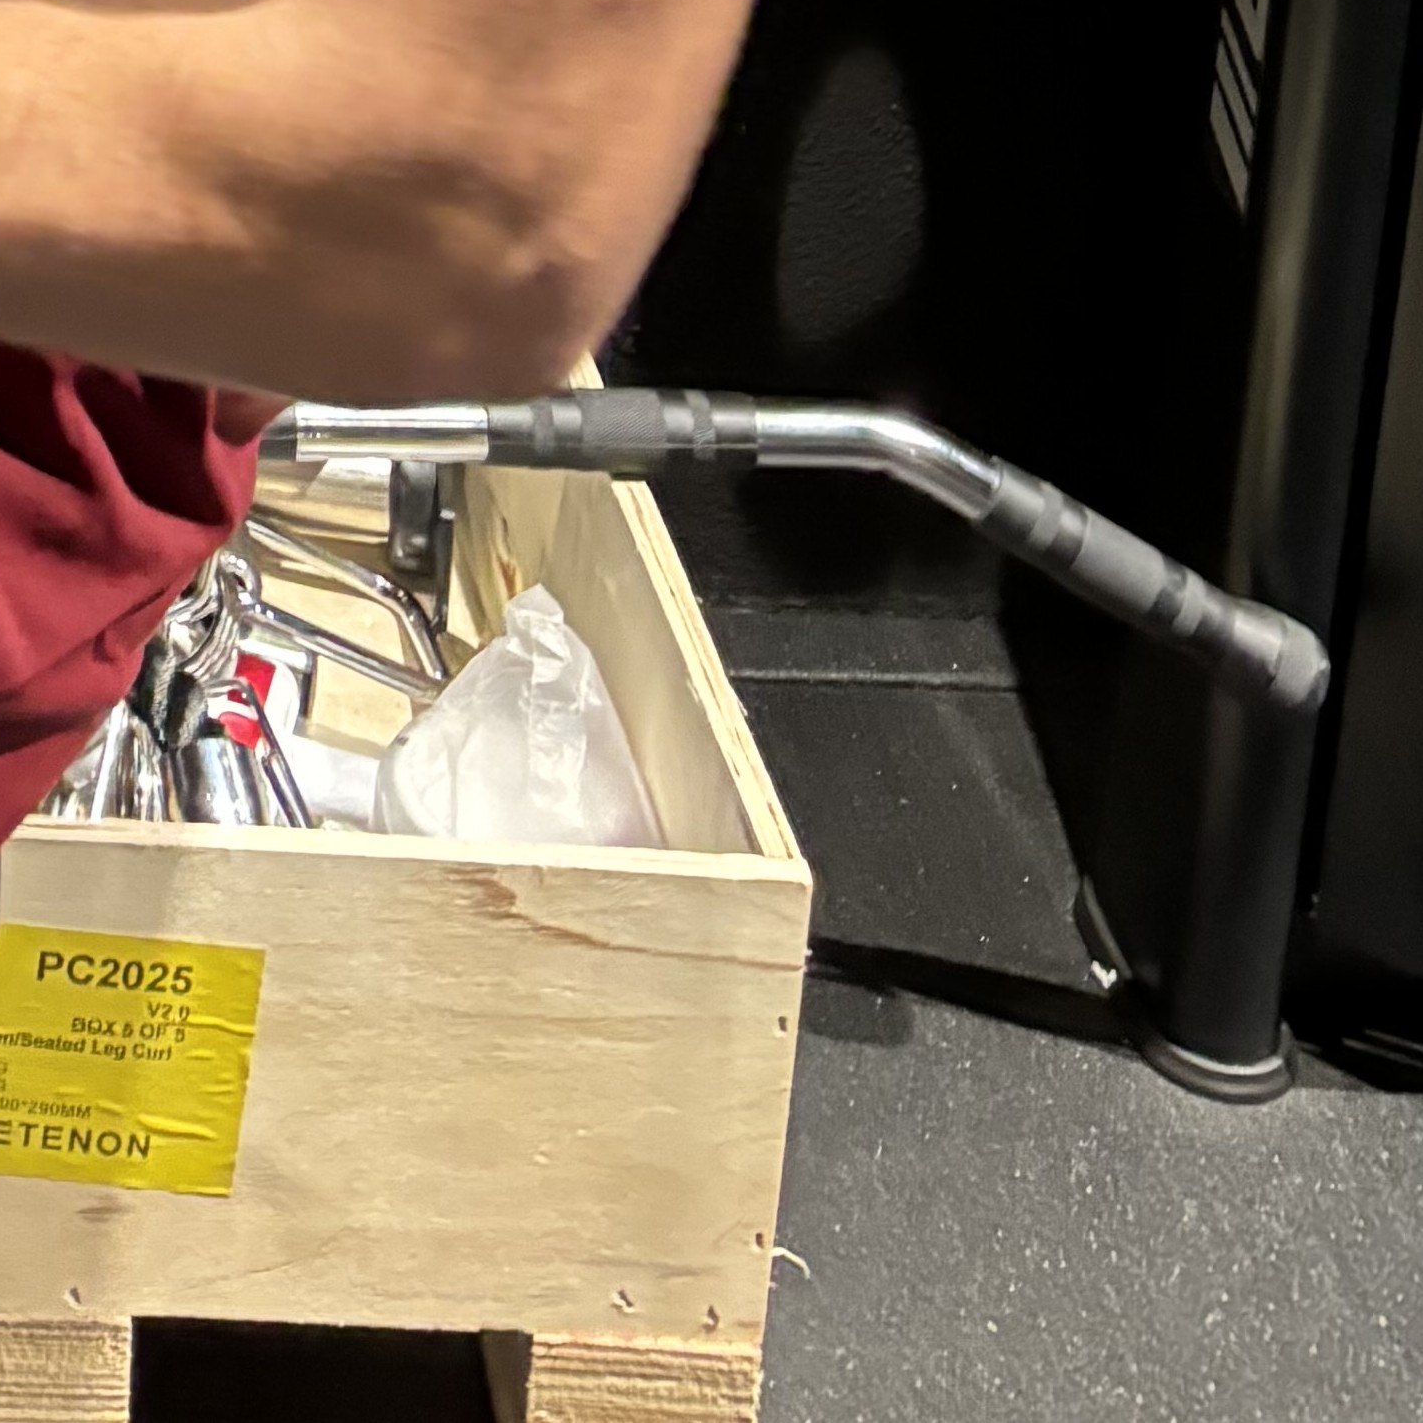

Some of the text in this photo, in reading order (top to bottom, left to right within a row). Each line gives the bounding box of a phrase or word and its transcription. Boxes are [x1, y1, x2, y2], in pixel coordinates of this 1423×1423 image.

[36, 950, 194, 995] PC2025
[70, 1016, 117, 1037] BOX
[90, 1039, 127, 1061] Leg
[132, 1042, 173, 1061] Curl
